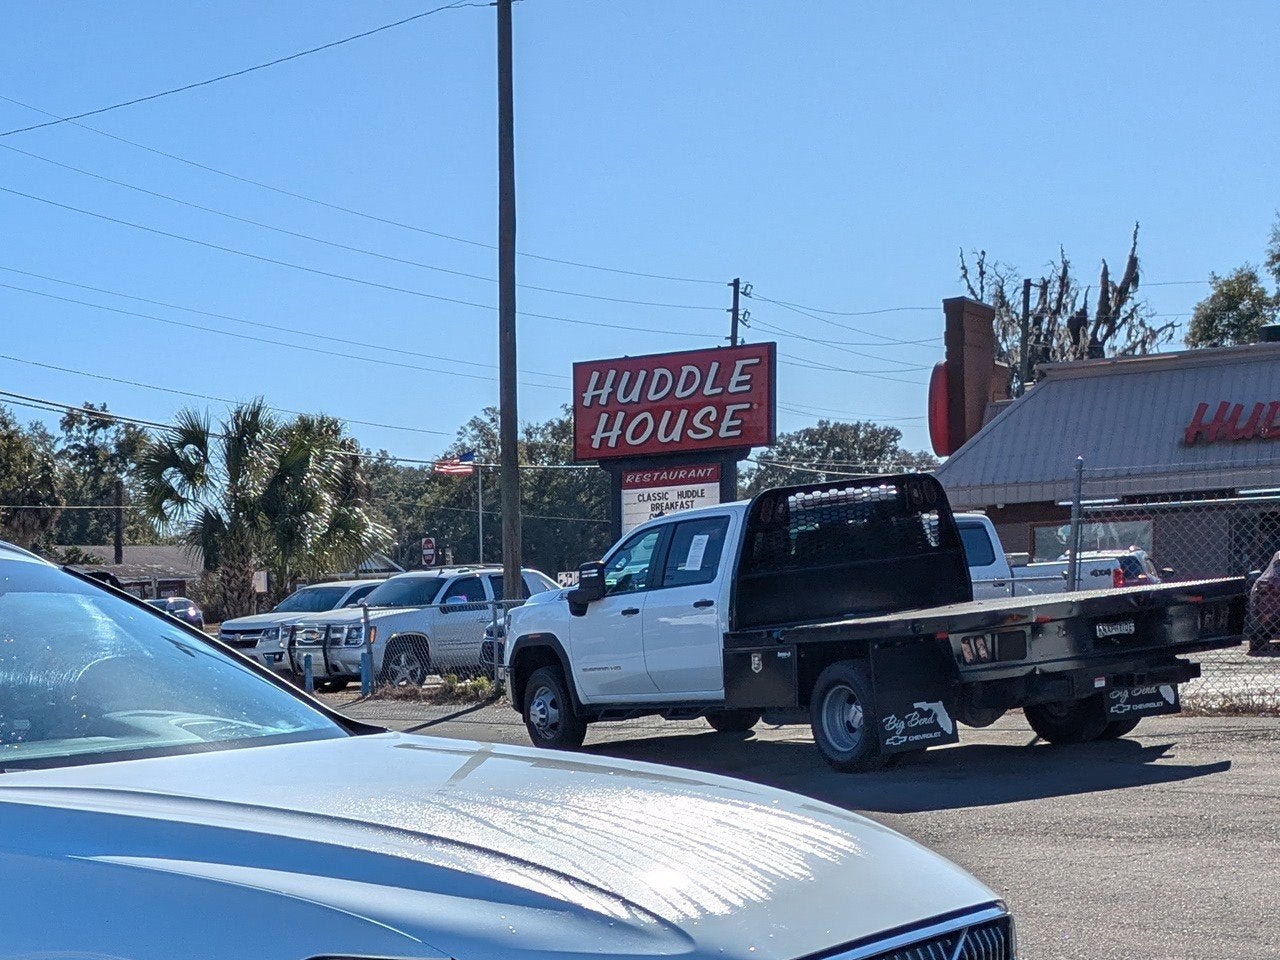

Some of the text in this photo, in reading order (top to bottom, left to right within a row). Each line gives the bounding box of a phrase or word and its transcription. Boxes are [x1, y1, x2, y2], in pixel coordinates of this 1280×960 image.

[582, 358, 760, 407] HUDDLE
[591, 402, 751, 449] HOUSE
[625, 467, 715, 484] RESTAURANT
[637, 488, 706, 503] CLASSIC HUDDLE
[650, 500, 695, 512] BREAKFAST
[882, 711, 937, 735] Big Bend
[908, 732, 941, 741] CHEVROLET
